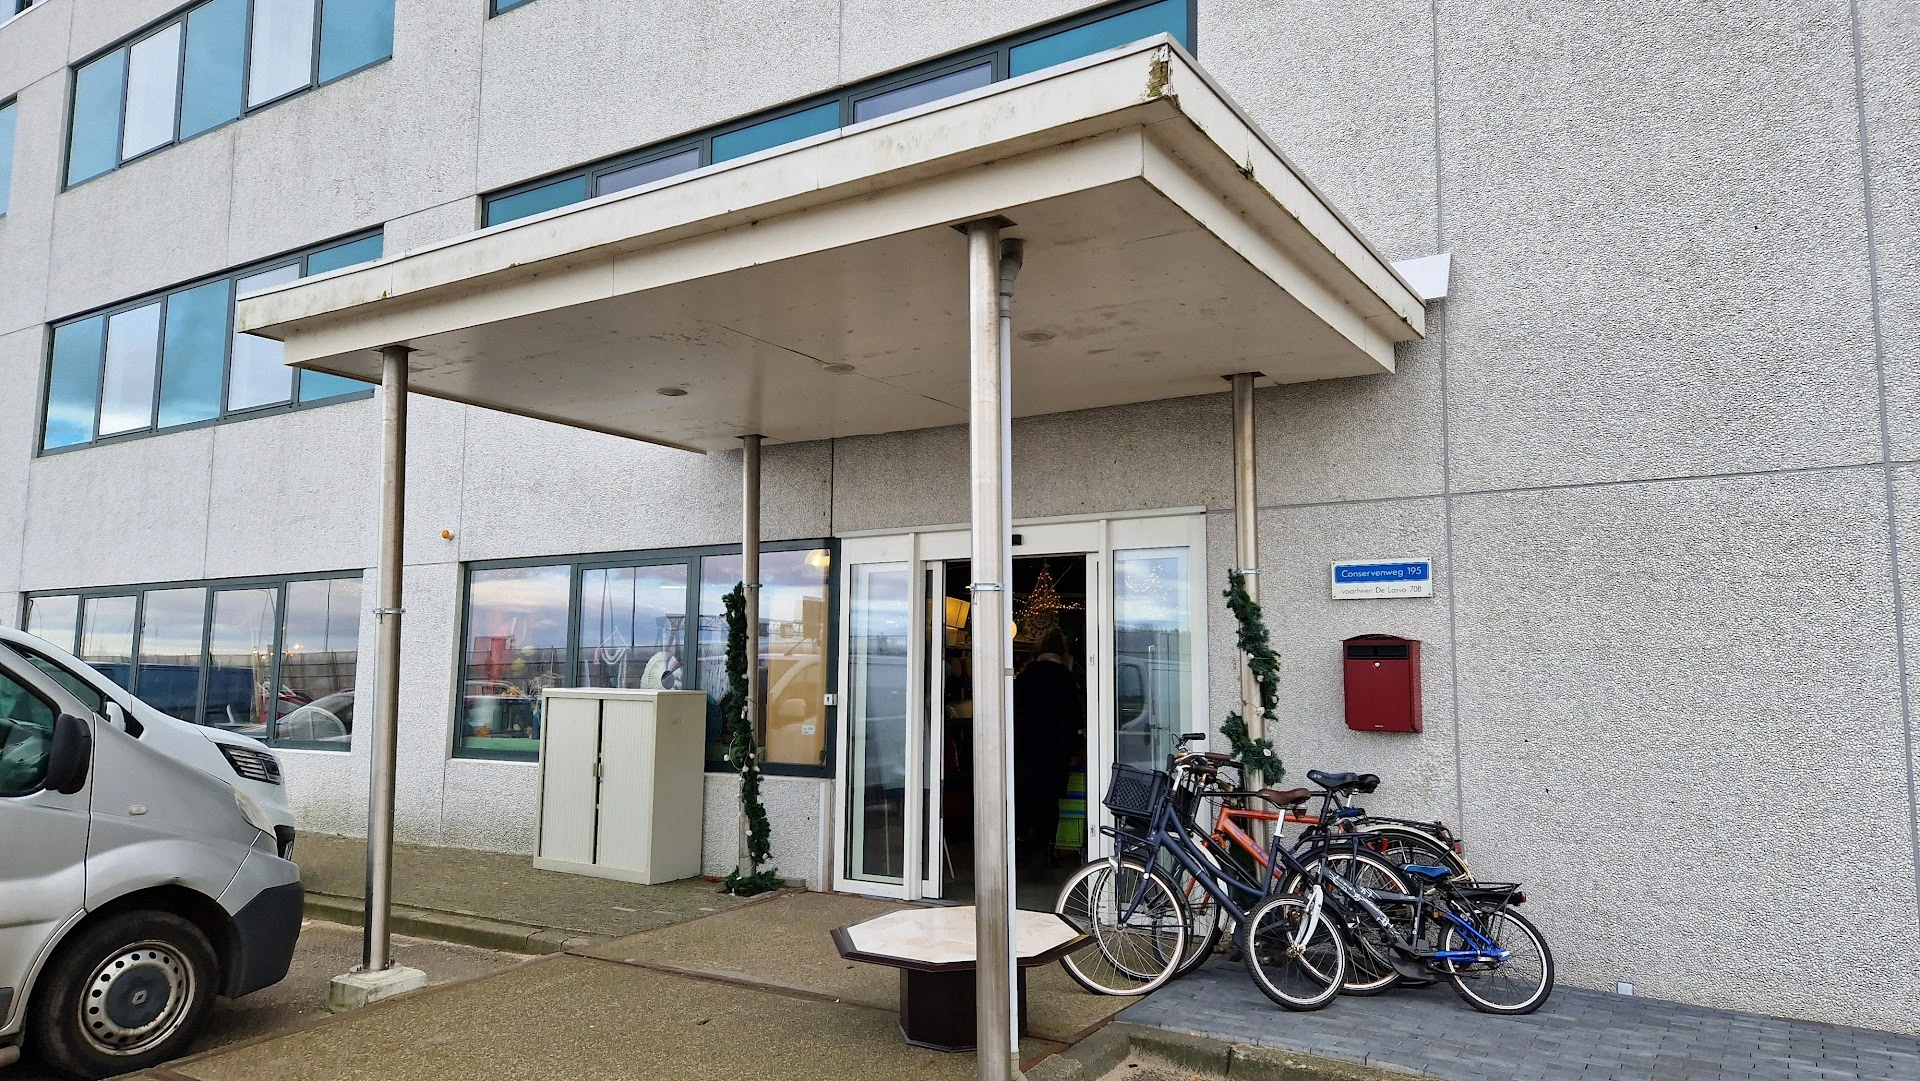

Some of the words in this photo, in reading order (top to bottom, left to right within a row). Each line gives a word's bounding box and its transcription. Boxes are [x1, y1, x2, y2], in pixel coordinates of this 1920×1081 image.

[1341, 569, 1404, 578] Conservenweg
[1407, 566, 1422, 575] 195
[1341, 587, 1373, 595] voorheen
[1375, 586, 1385, 594] De
[1387, 586, 1407, 594] Lasso
